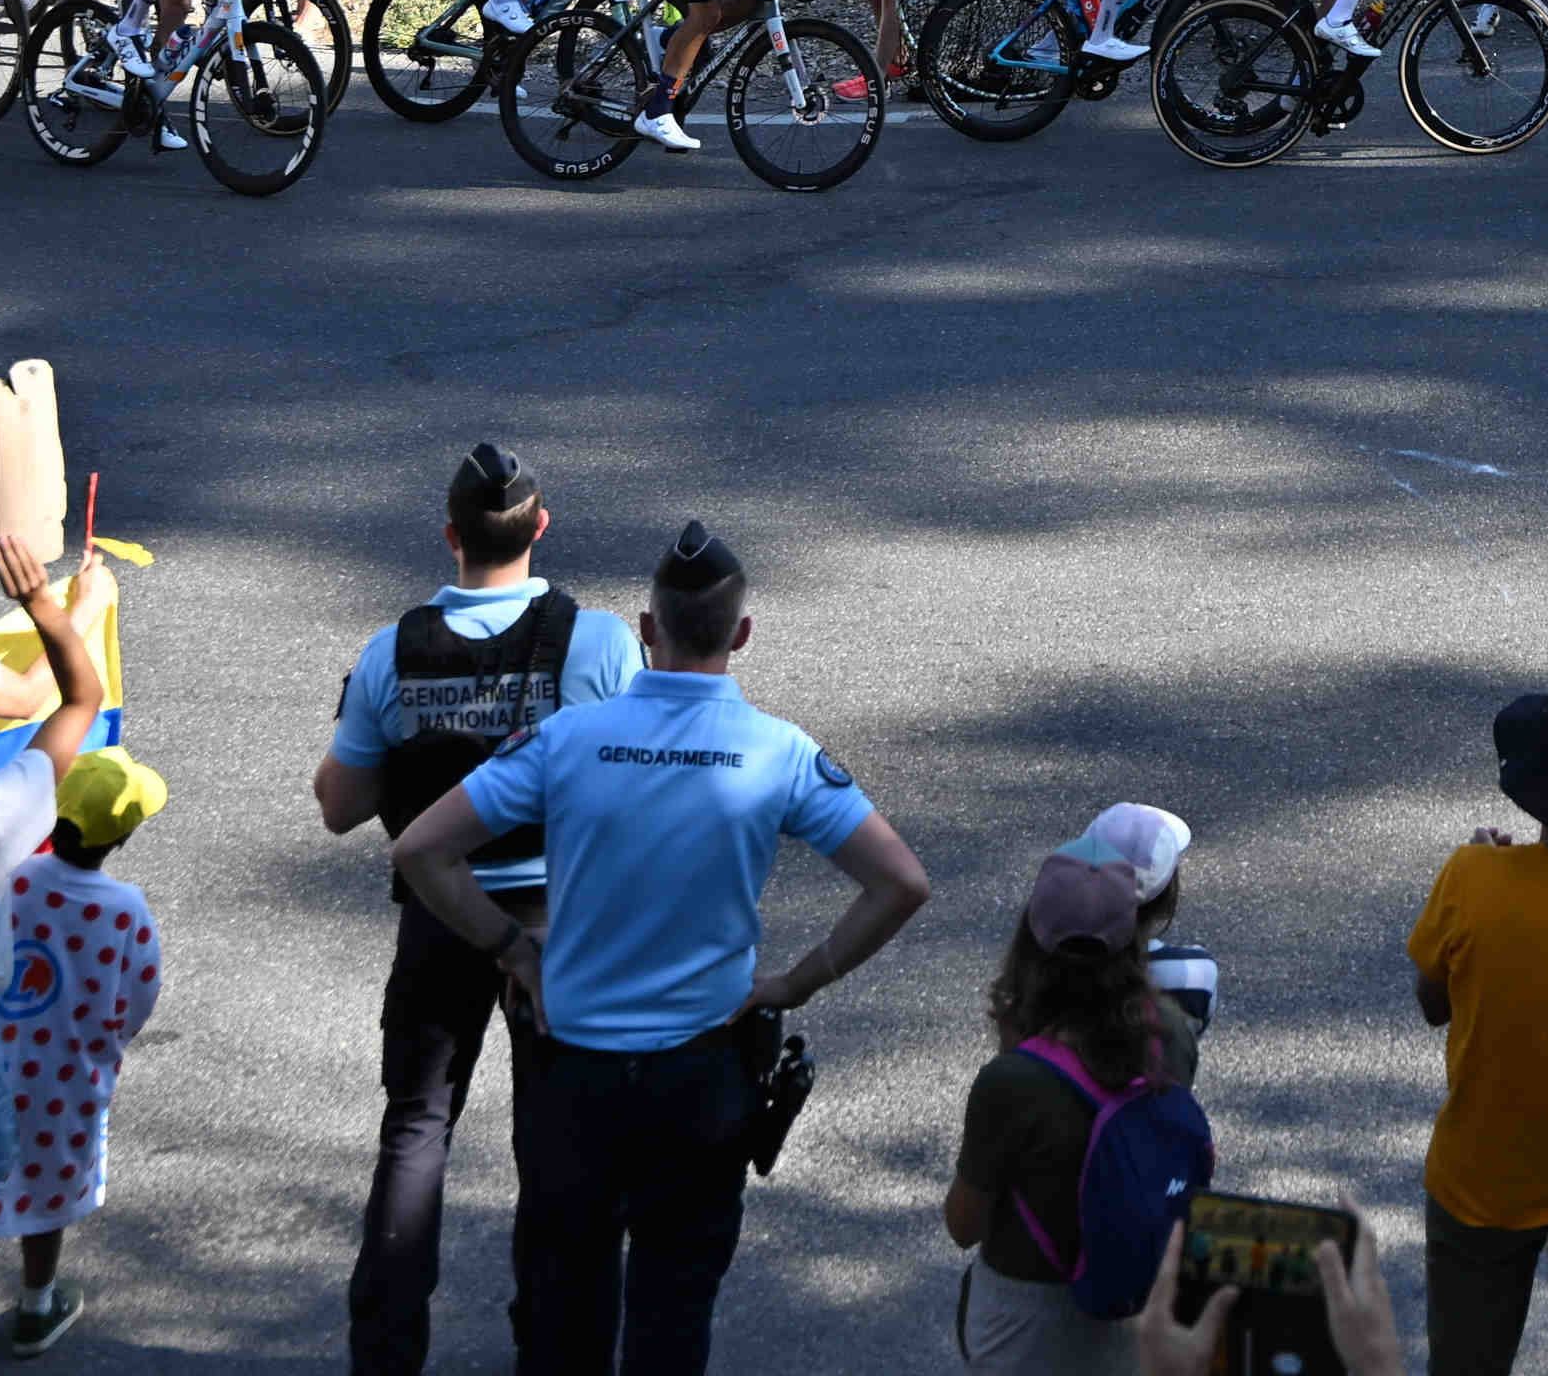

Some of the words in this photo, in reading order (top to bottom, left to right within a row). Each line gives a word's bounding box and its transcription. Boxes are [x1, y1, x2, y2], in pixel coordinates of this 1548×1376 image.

[401, 679, 555, 708] GENDARMERIE
[417, 705, 537, 732] NATIONALE
[598, 745, 743, 769] GENDARMERIE
